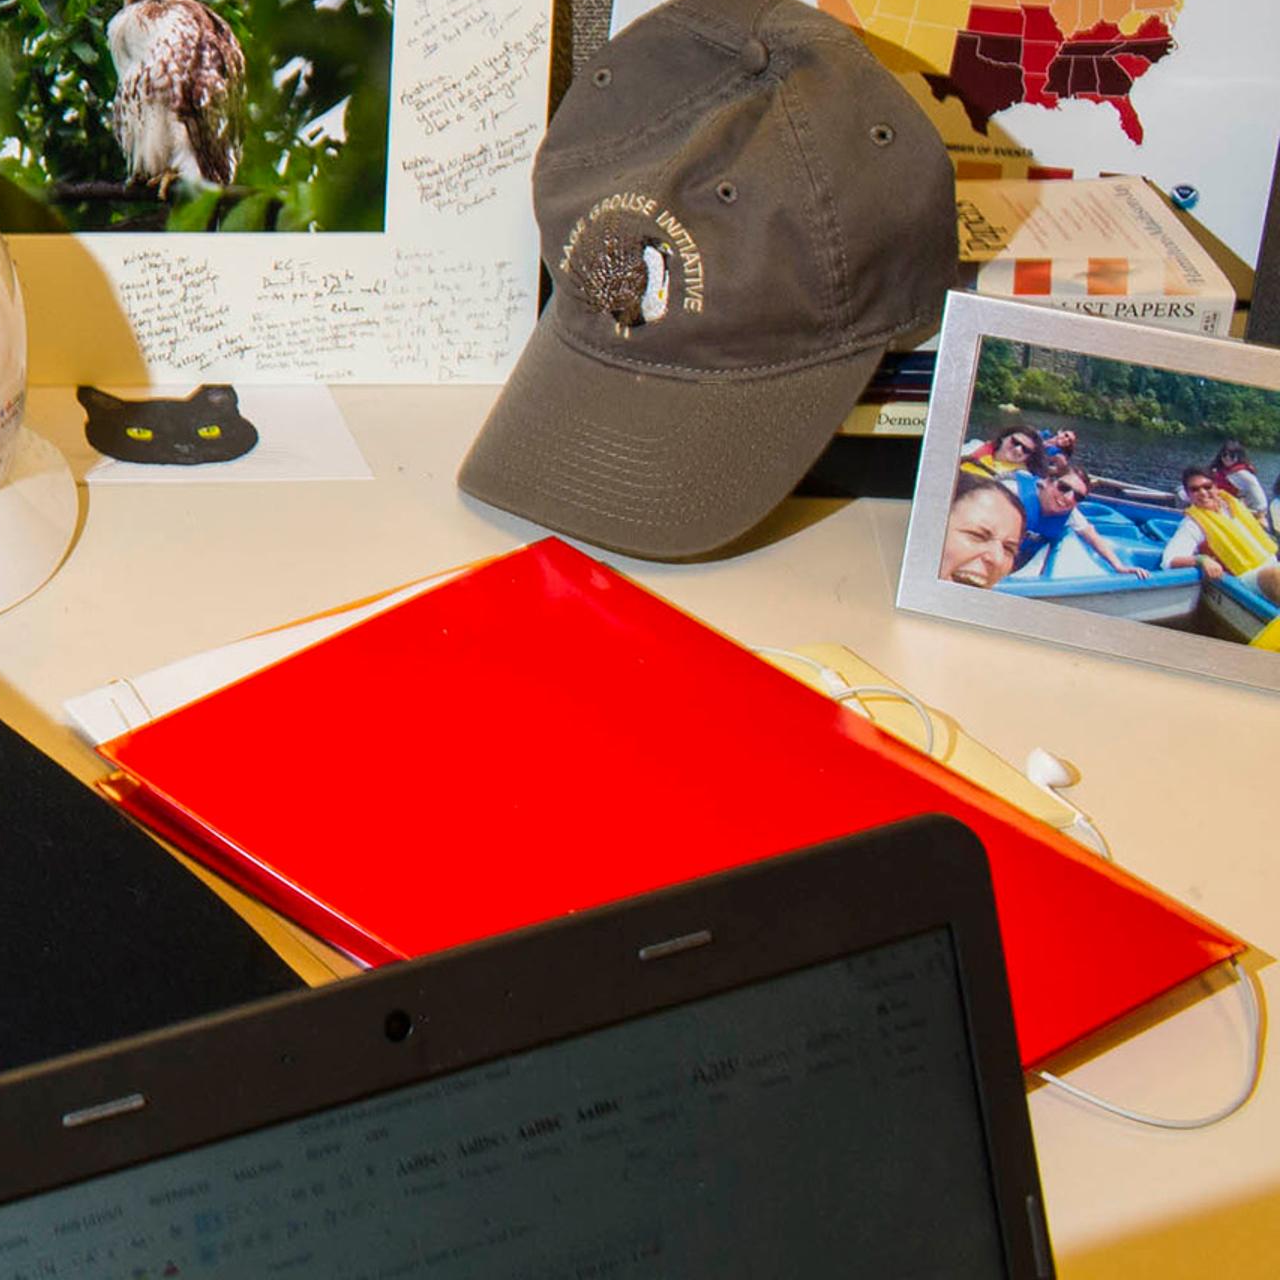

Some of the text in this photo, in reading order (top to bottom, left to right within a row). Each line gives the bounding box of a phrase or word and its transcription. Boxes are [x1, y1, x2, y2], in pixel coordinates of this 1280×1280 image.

[993, 147, 1034, 157] EVENTS
[559, 192, 704, 314] SAGE GROUSE INITIATIVE
[1114, 302, 1196, 318] PAPERS
